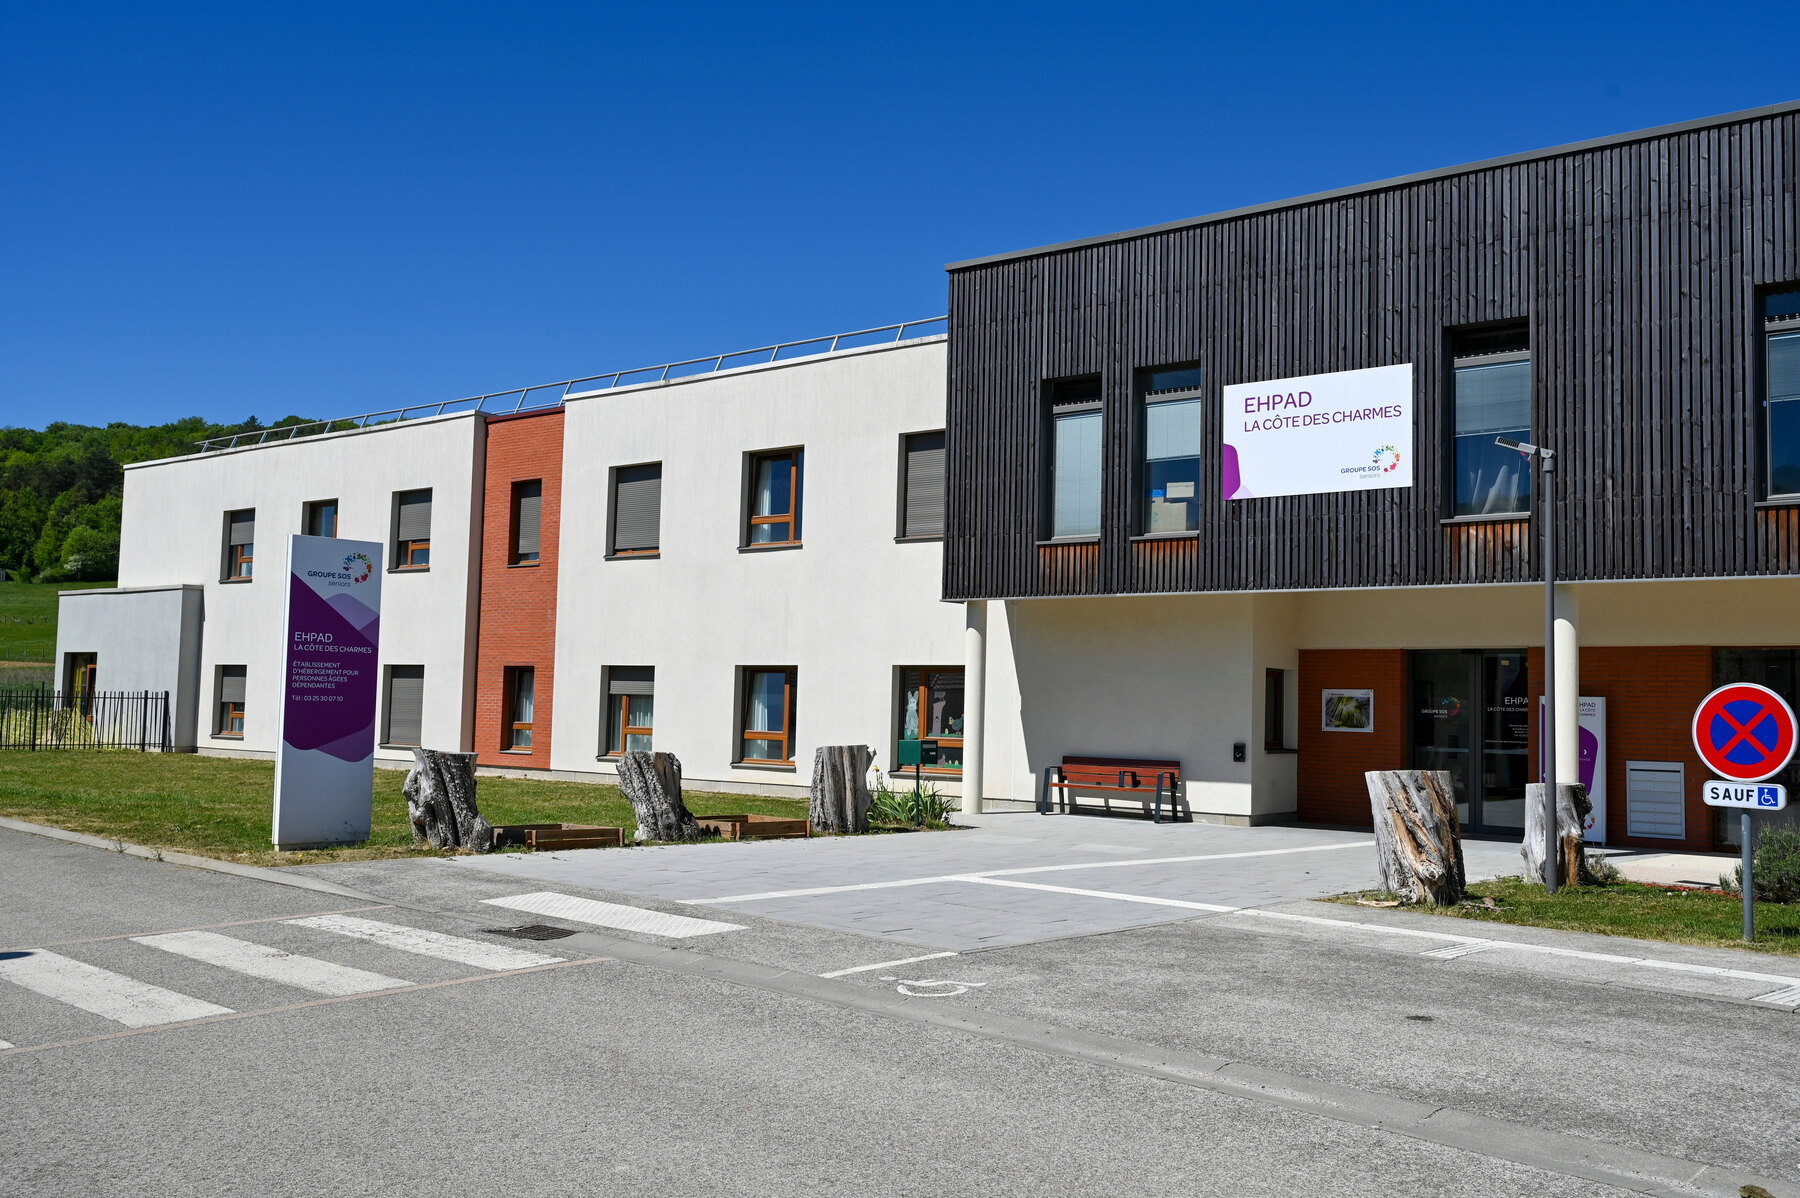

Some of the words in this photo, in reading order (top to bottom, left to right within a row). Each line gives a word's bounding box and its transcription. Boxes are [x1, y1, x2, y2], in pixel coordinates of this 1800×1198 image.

[1244, 391, 1312, 413] EHPAD
[1244, 420, 1261, 432] LA
[1263, 414, 1300, 431] CÔTE
[1303, 412, 1330, 427] DES
[1332, 405, 1402, 423] CHARMES
[1340, 466, 1366, 474] GROUPE
[307, 570, 337, 579] GROUPE
[328, 580, 351, 588] seniors
[294, 631, 333, 643] EHPAD
[304, 643, 324, 652] CÔTE
[339, 646, 372, 654] CHARMES
[292, 660, 341, 668] ÉTABLISSEMENT
[1504, 696, 1528, 705] EHPA
[1710, 787, 1755, 802] SAUF
